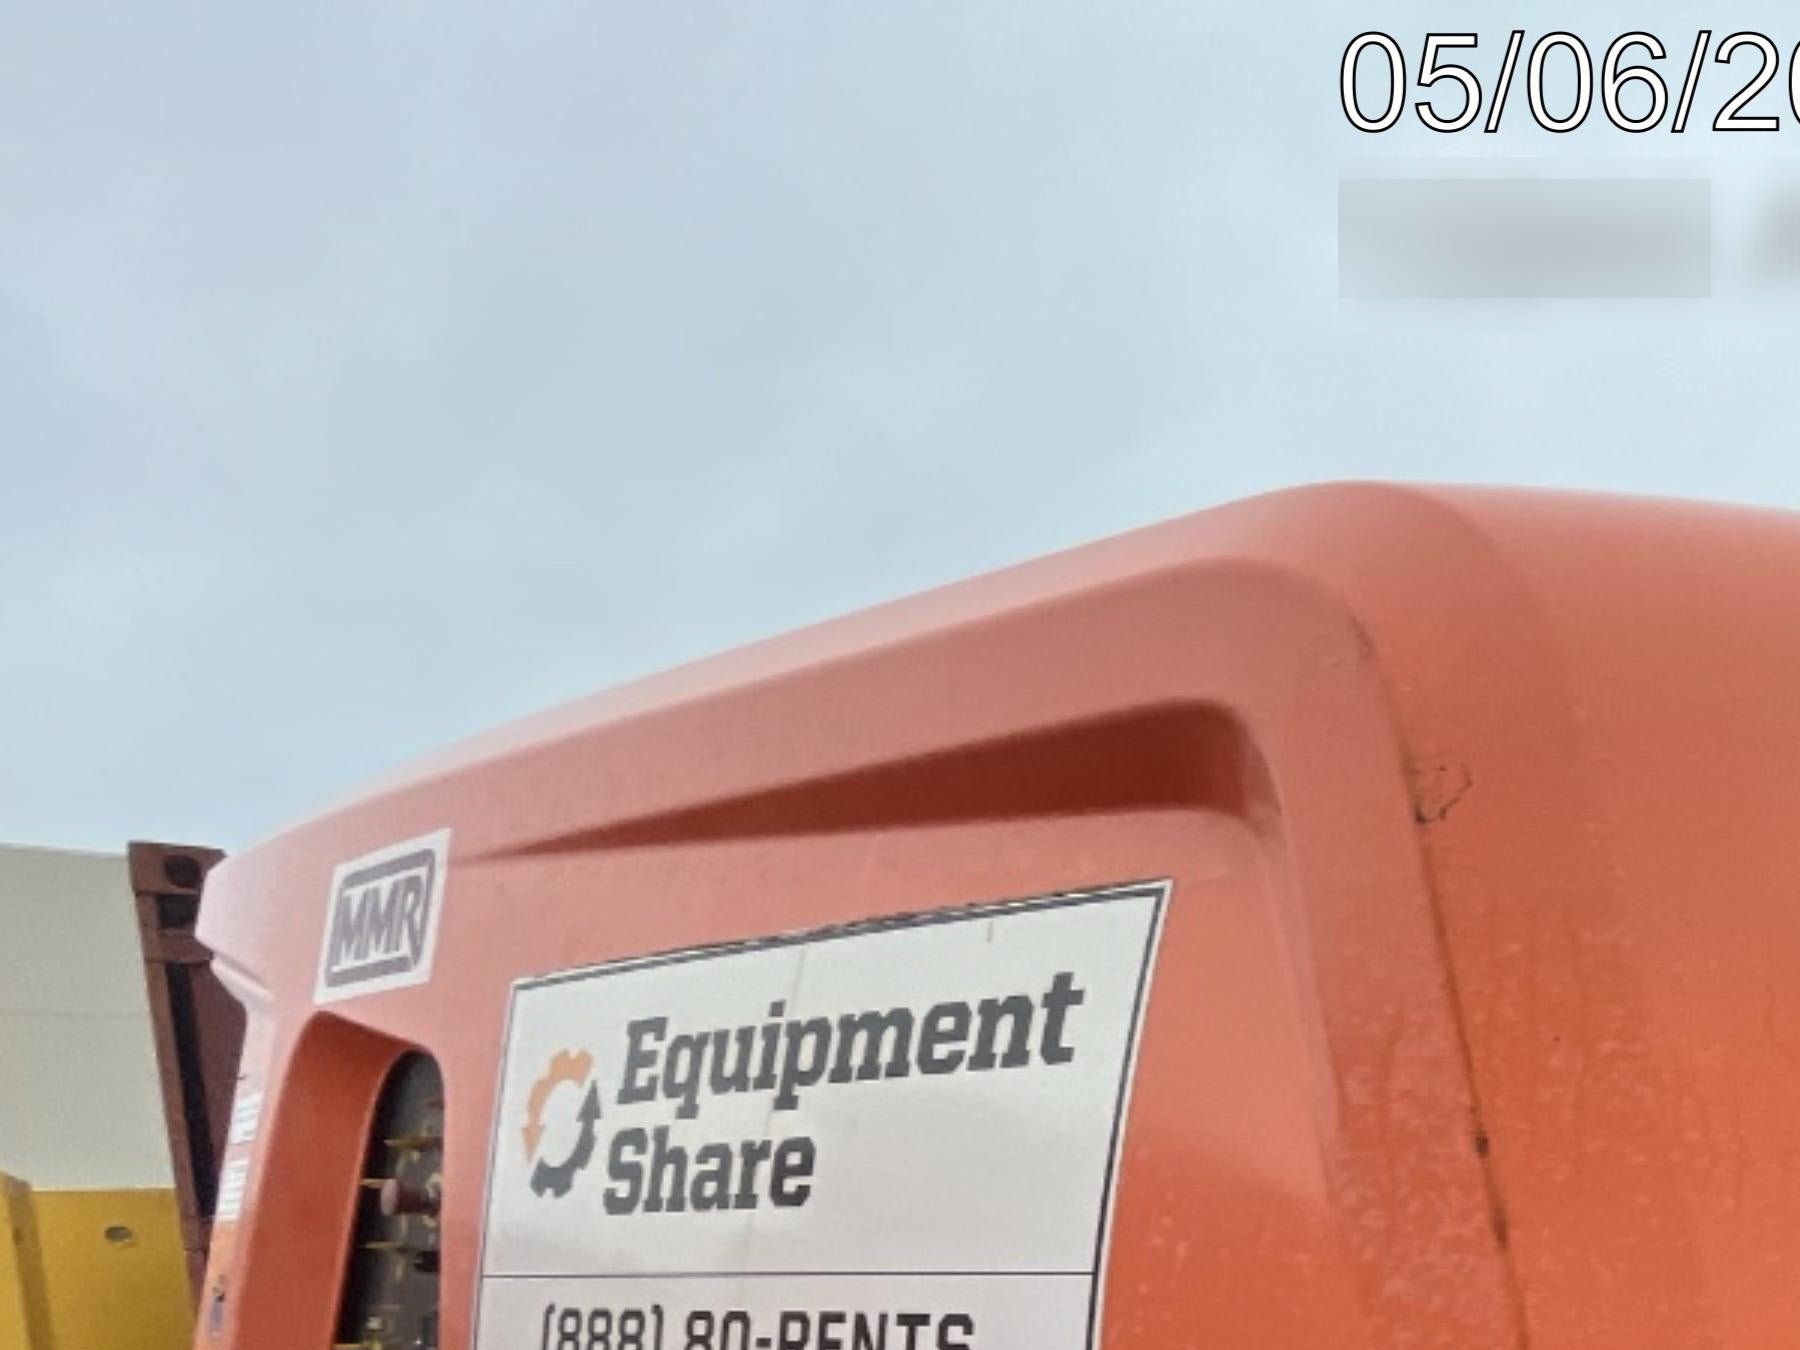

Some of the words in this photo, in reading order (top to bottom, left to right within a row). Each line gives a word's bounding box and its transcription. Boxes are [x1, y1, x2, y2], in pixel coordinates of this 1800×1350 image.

[328, 875, 424, 967] MMR
[616, 971, 1085, 1119] Equipment
[602, 1125, 817, 1216] Share
